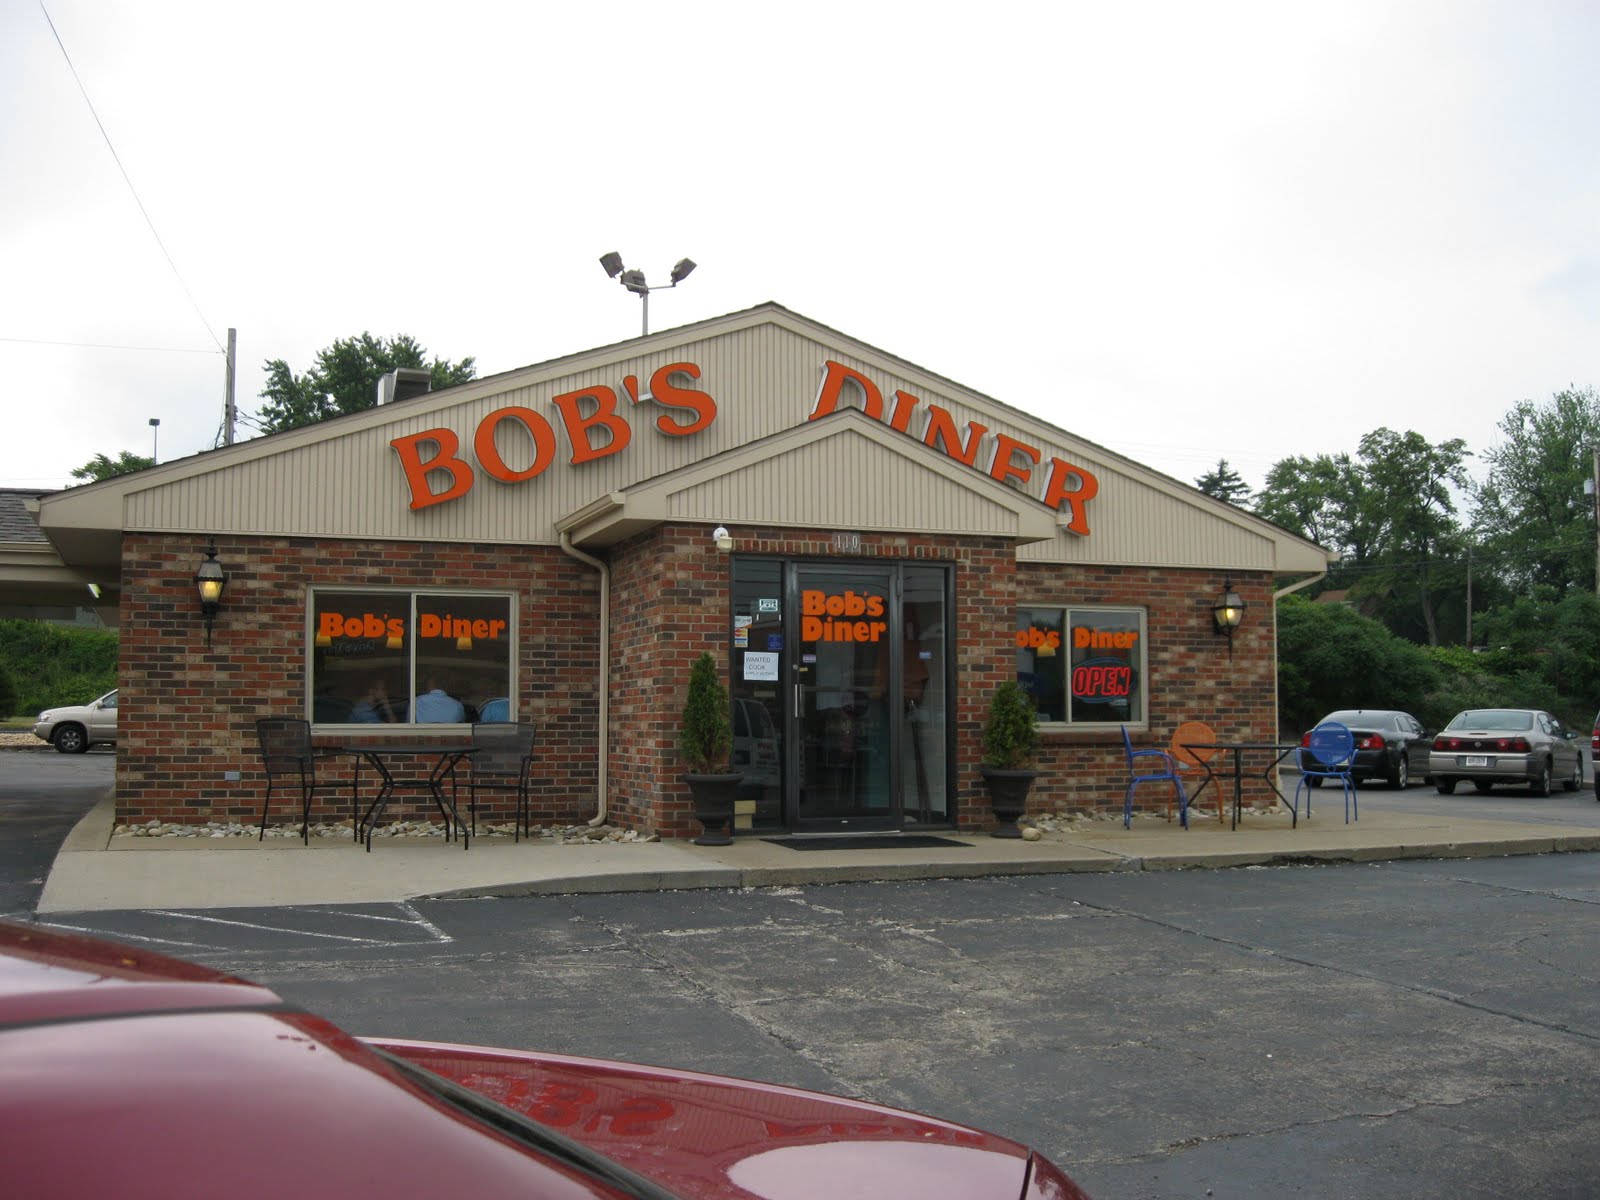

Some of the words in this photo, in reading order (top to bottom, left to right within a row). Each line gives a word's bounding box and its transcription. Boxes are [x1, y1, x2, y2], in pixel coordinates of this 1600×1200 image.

[389, 361, 717, 511] BOB'S
[808, 359, 1099, 536] DINER
[837, 535, 858, 549] 110
[802, 590, 885, 617] Bob's
[319, 612, 404, 638] Bob's
[420, 613, 506, 639] Diner
[802, 616, 887, 642] Diner
[1016, 625, 1060, 649] ob's
[1074, 626, 1138, 649] Diner
[1072, 666, 1131, 696] OPEN
